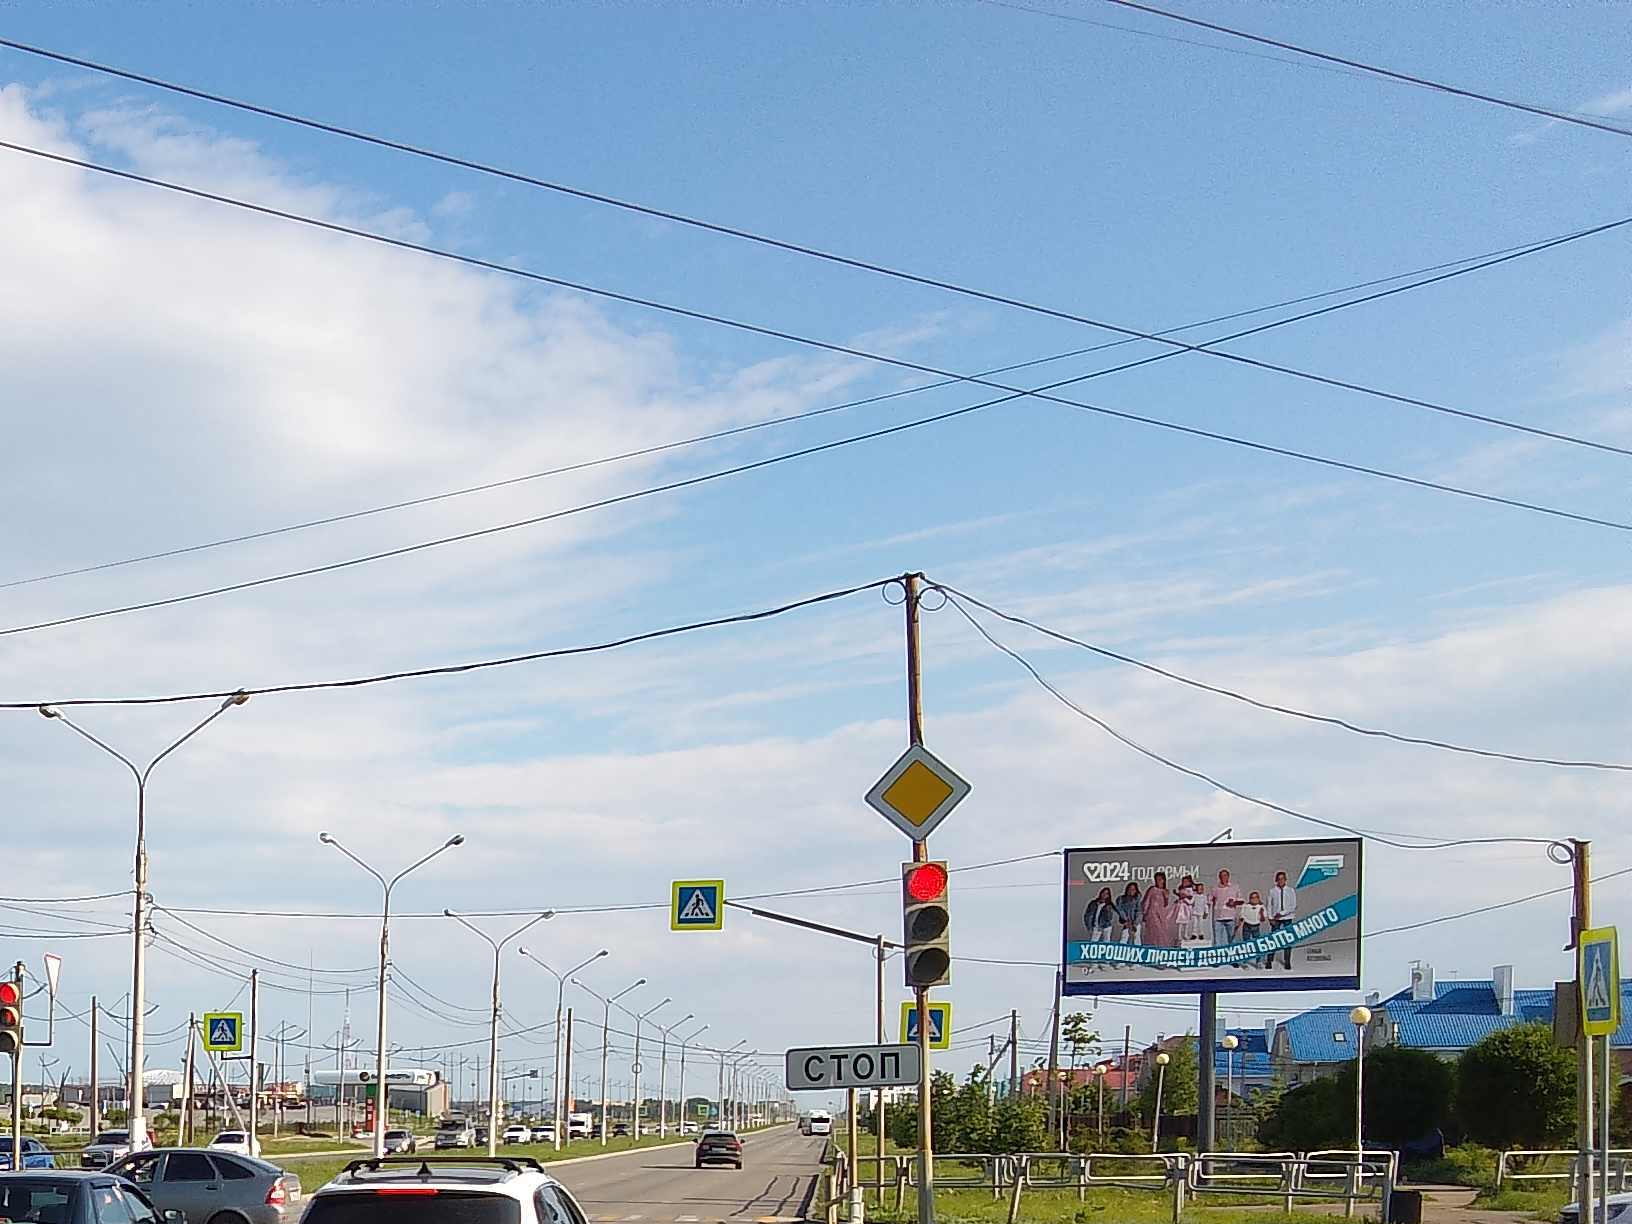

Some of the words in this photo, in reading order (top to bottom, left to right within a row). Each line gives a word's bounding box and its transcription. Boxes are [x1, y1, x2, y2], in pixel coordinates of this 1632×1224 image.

[1091, 862, 1130, 881] 2024
[1081, 944, 1145, 963] ХОРОШИХ
[1198, 942, 1256, 967] ДОЛЖНО
[1258, 929, 1295, 952] БЫТЬ
[1293, 907, 1338, 938] МНОГО
[804, 1052, 900, 1082] СТОП
